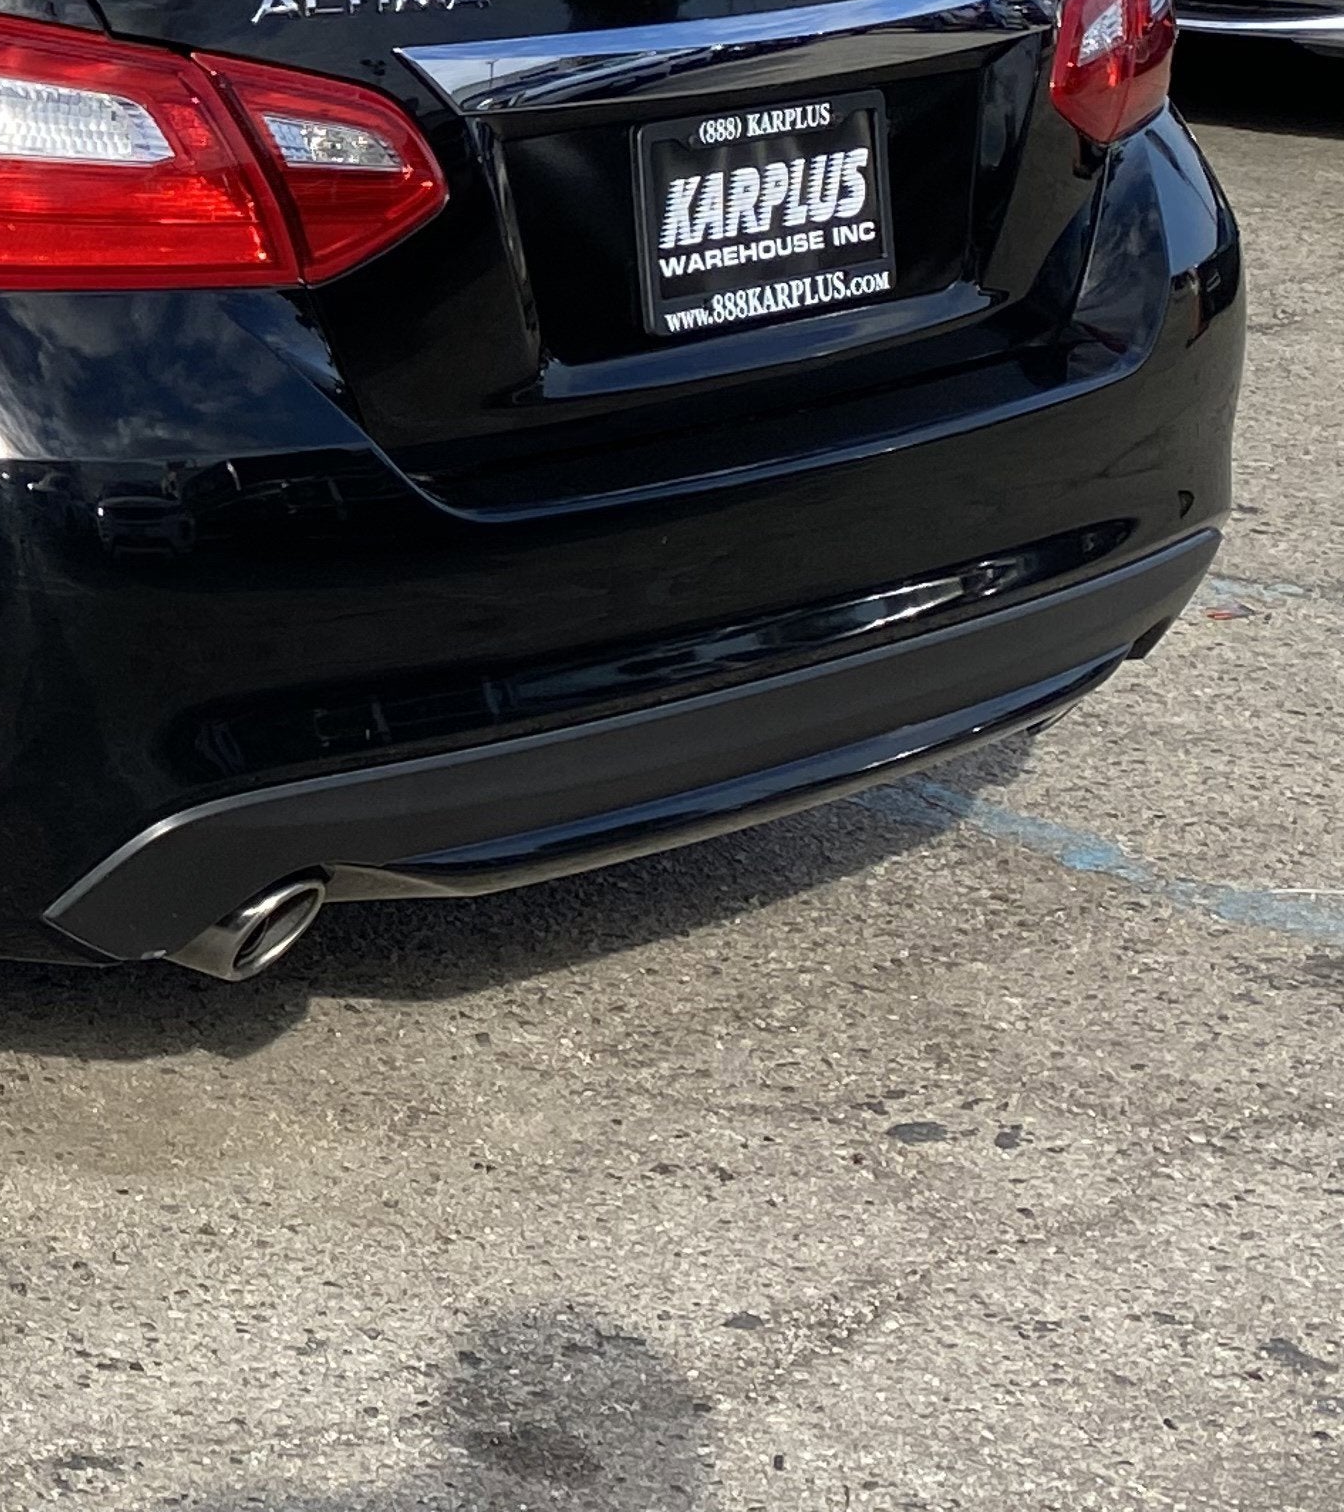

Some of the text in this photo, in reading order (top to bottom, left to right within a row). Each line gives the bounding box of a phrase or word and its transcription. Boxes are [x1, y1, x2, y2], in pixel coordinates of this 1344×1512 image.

[698, 102, 831, 145] (888) KARPLUS
[658, 147, 869, 250] KARPLUS
[659, 221, 876, 279] WAREHOUSE INC
